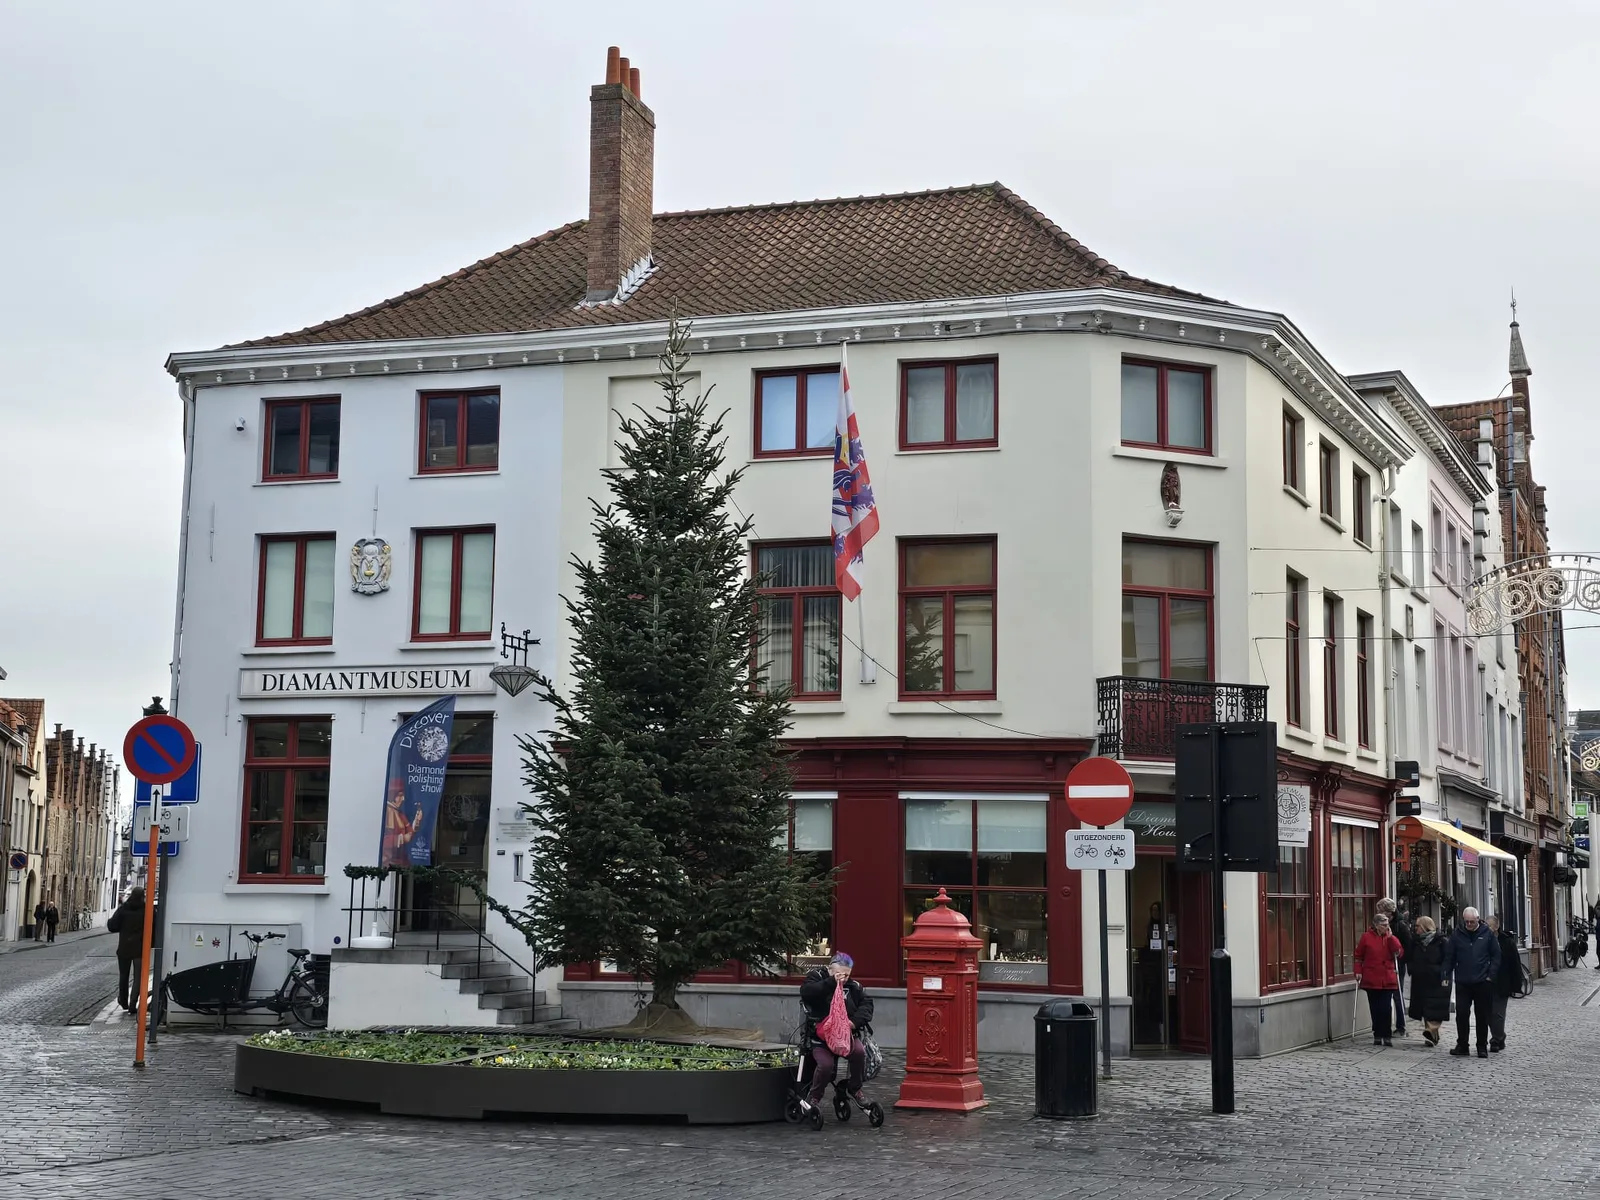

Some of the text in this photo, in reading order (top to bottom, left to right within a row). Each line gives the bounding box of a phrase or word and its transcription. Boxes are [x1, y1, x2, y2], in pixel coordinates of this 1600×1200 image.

[261, 669, 472, 692] DIAMANTMUSEUM
[400, 712, 449, 748] Discover
[408, 764, 445, 775] Diamond
[408, 774, 443, 786] polishing
[421, 783, 441, 793] show
[993, 965, 1034, 974] Diamant
